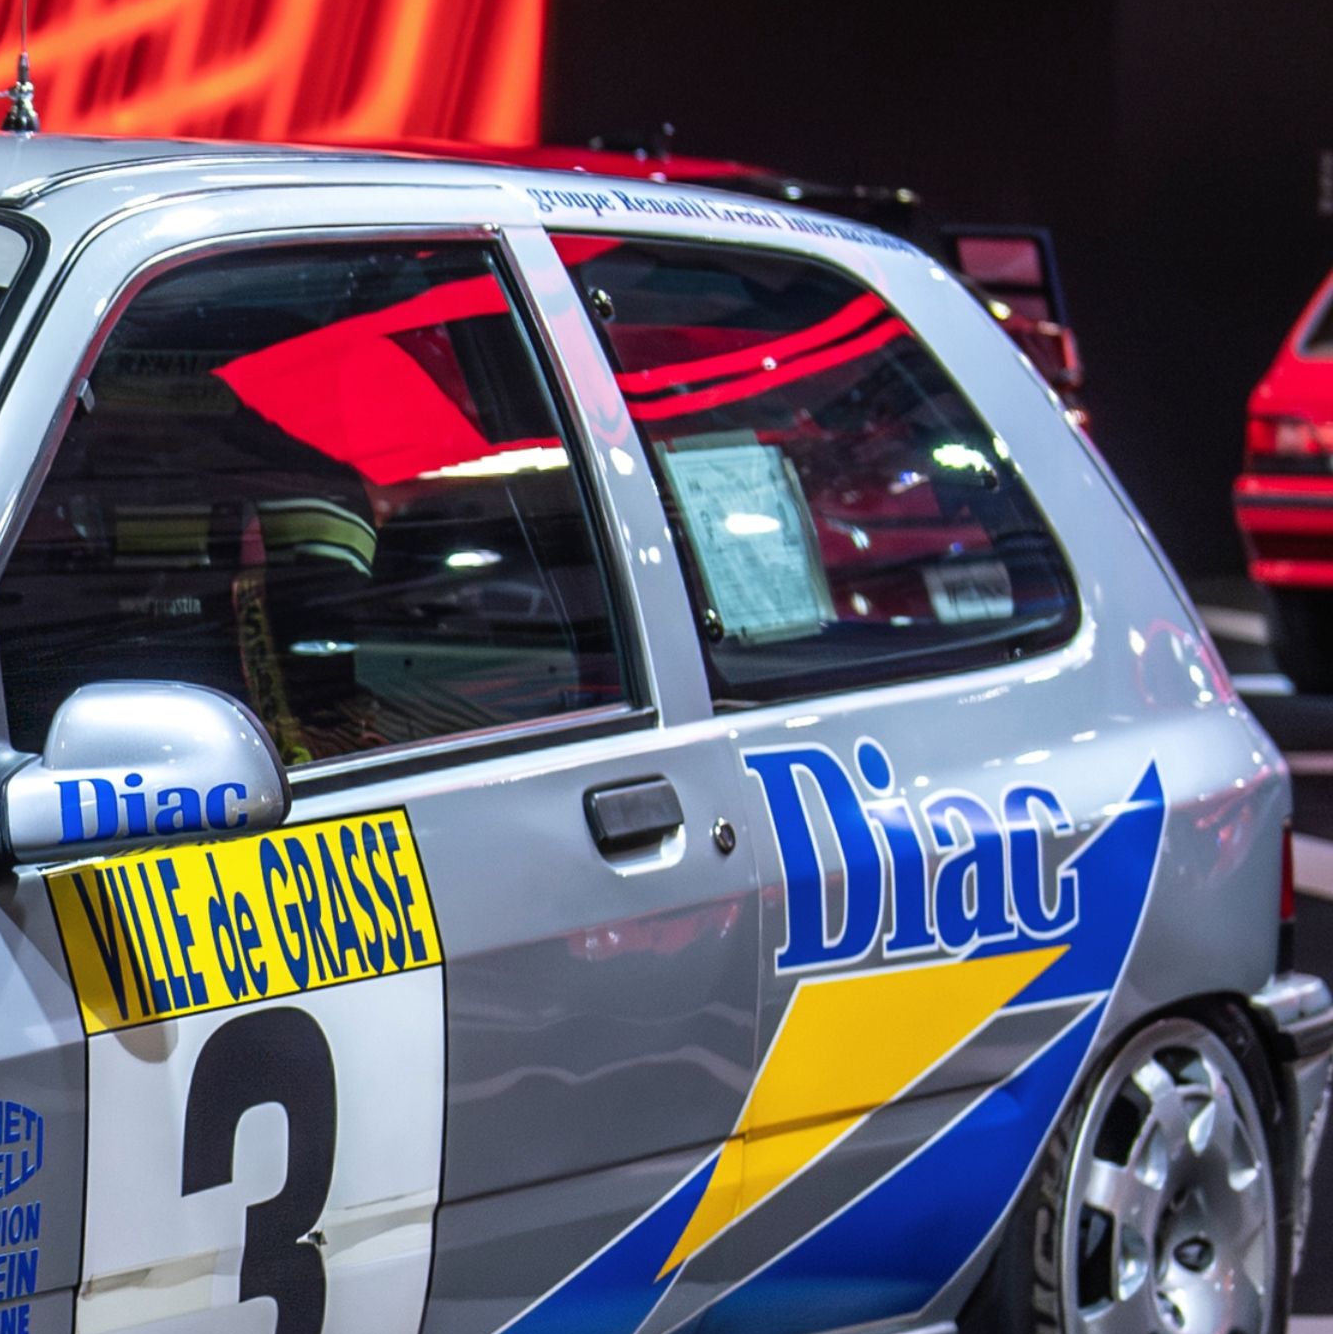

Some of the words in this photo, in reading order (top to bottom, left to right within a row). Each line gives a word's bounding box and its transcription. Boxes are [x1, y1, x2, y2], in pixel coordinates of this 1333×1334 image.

[526, 187, 617, 217] groupe
[610, 189, 713, 220] Renault
[55, 772, 249, 845] Diac
[742, 737, 1078, 972] Diac
[72, 857, 211, 1021] VILLE
[206, 851, 269, 1002] de
[259, 821, 429, 990] GRASSE
